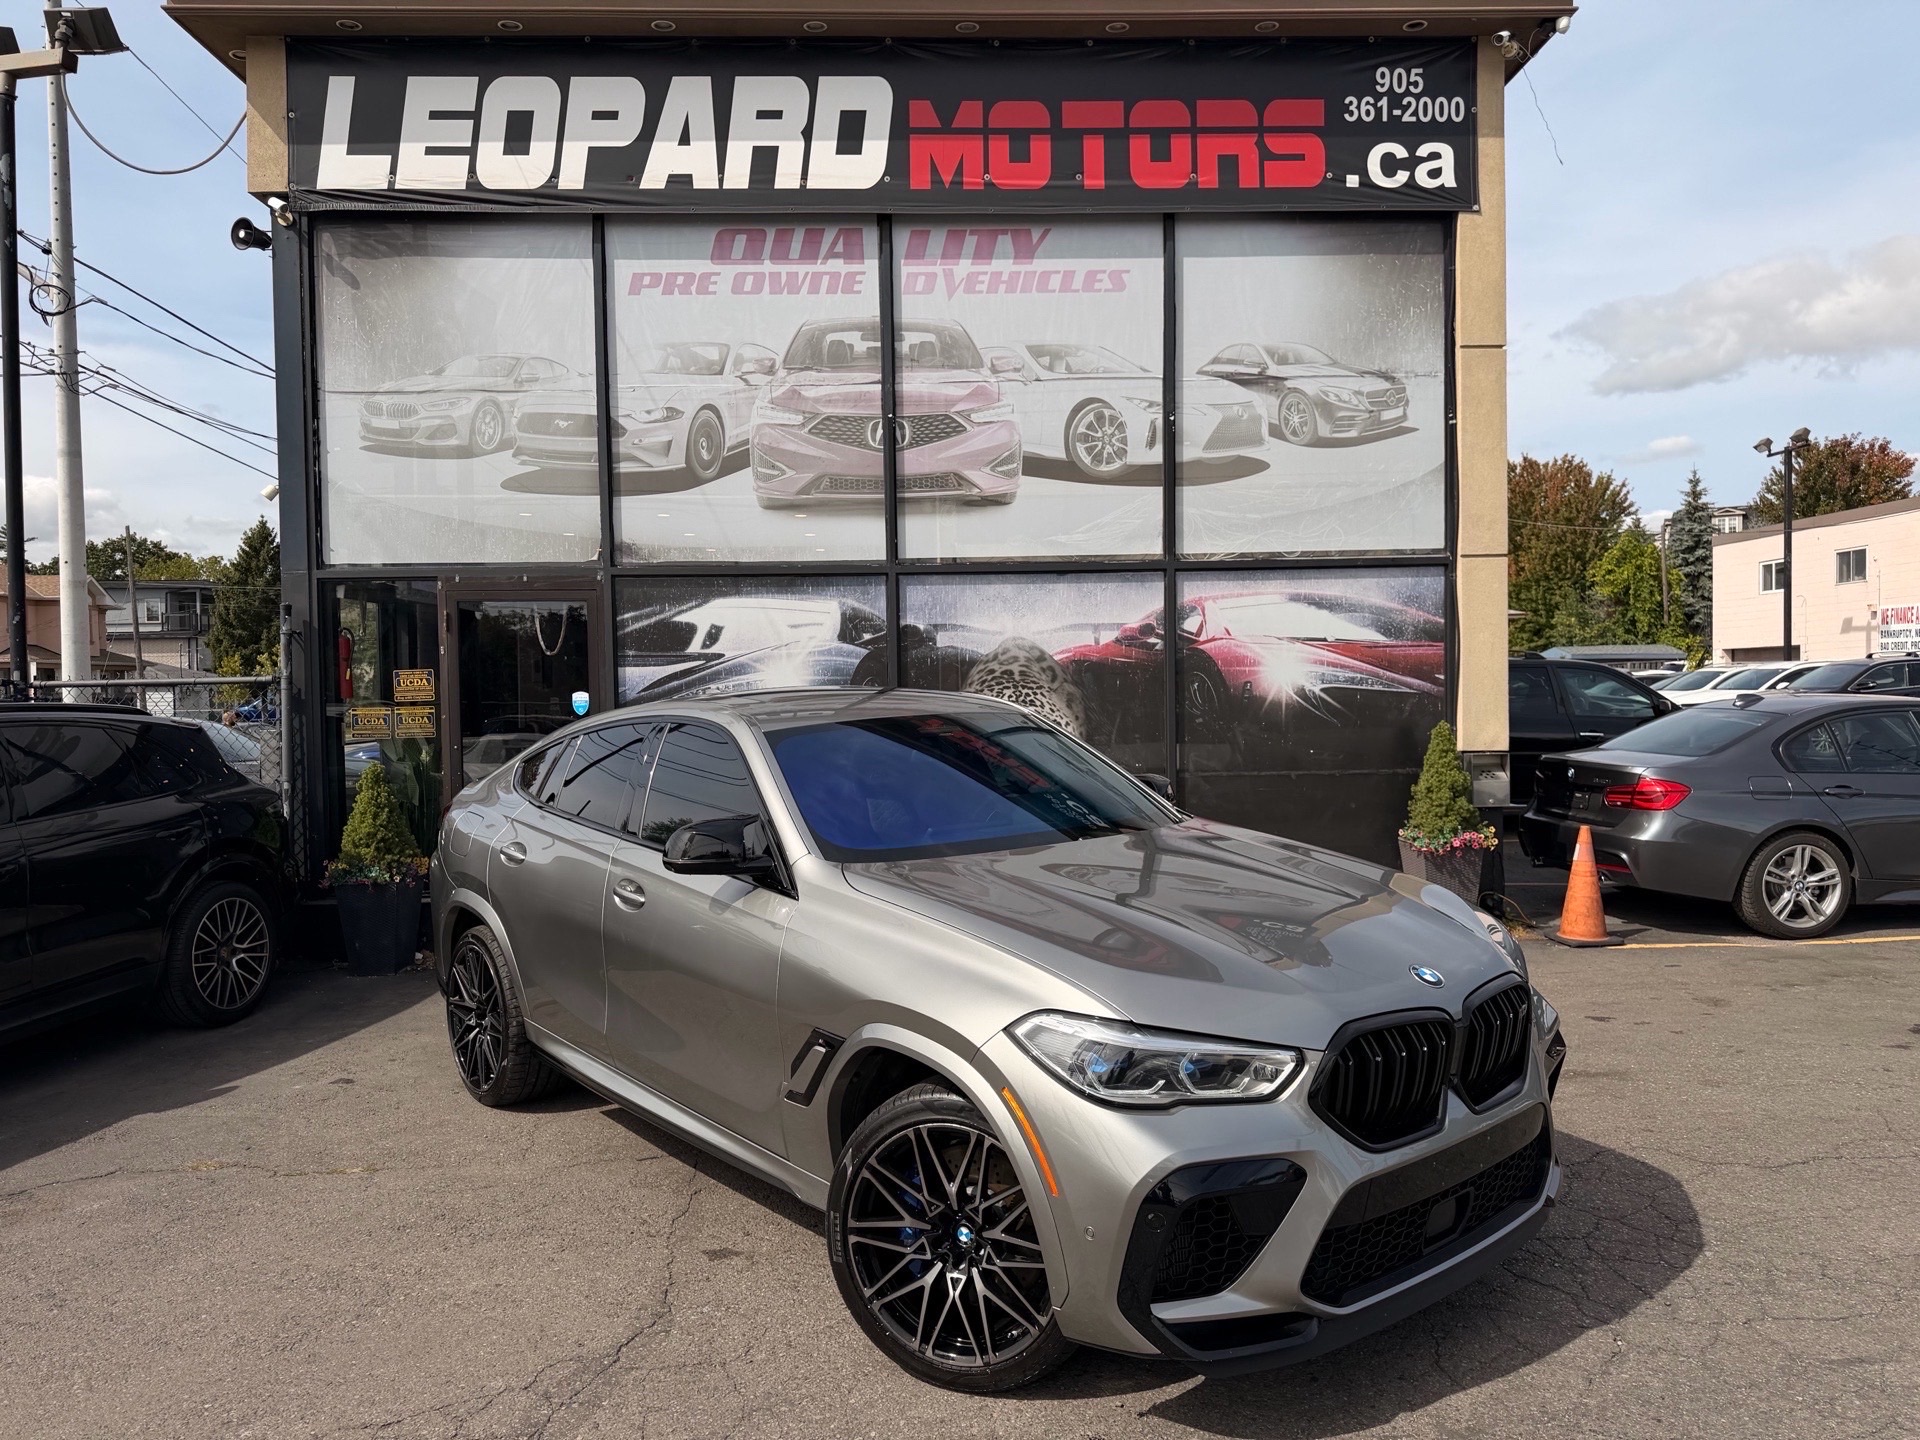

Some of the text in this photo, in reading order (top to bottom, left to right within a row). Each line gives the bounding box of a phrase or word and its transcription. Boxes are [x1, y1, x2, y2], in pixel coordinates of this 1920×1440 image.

[1375, 67, 1424, 94] 905
[1343, 95, 1465, 123] 361-2000
[316, 76, 1327, 190] LEOPARD MOTORS
[1345, 141, 1458, 189] .ca
[628, 272, 725, 297] PRE
[1881, 608, 1889, 625] WE
[1891, 606, 1914, 625] FINANCE
[1881, 642, 1889, 651] BAD
[400, 678, 429, 687] UCDA
[358, 717, 385, 725] UCDA
[402, 716, 429, 724] UCDA
